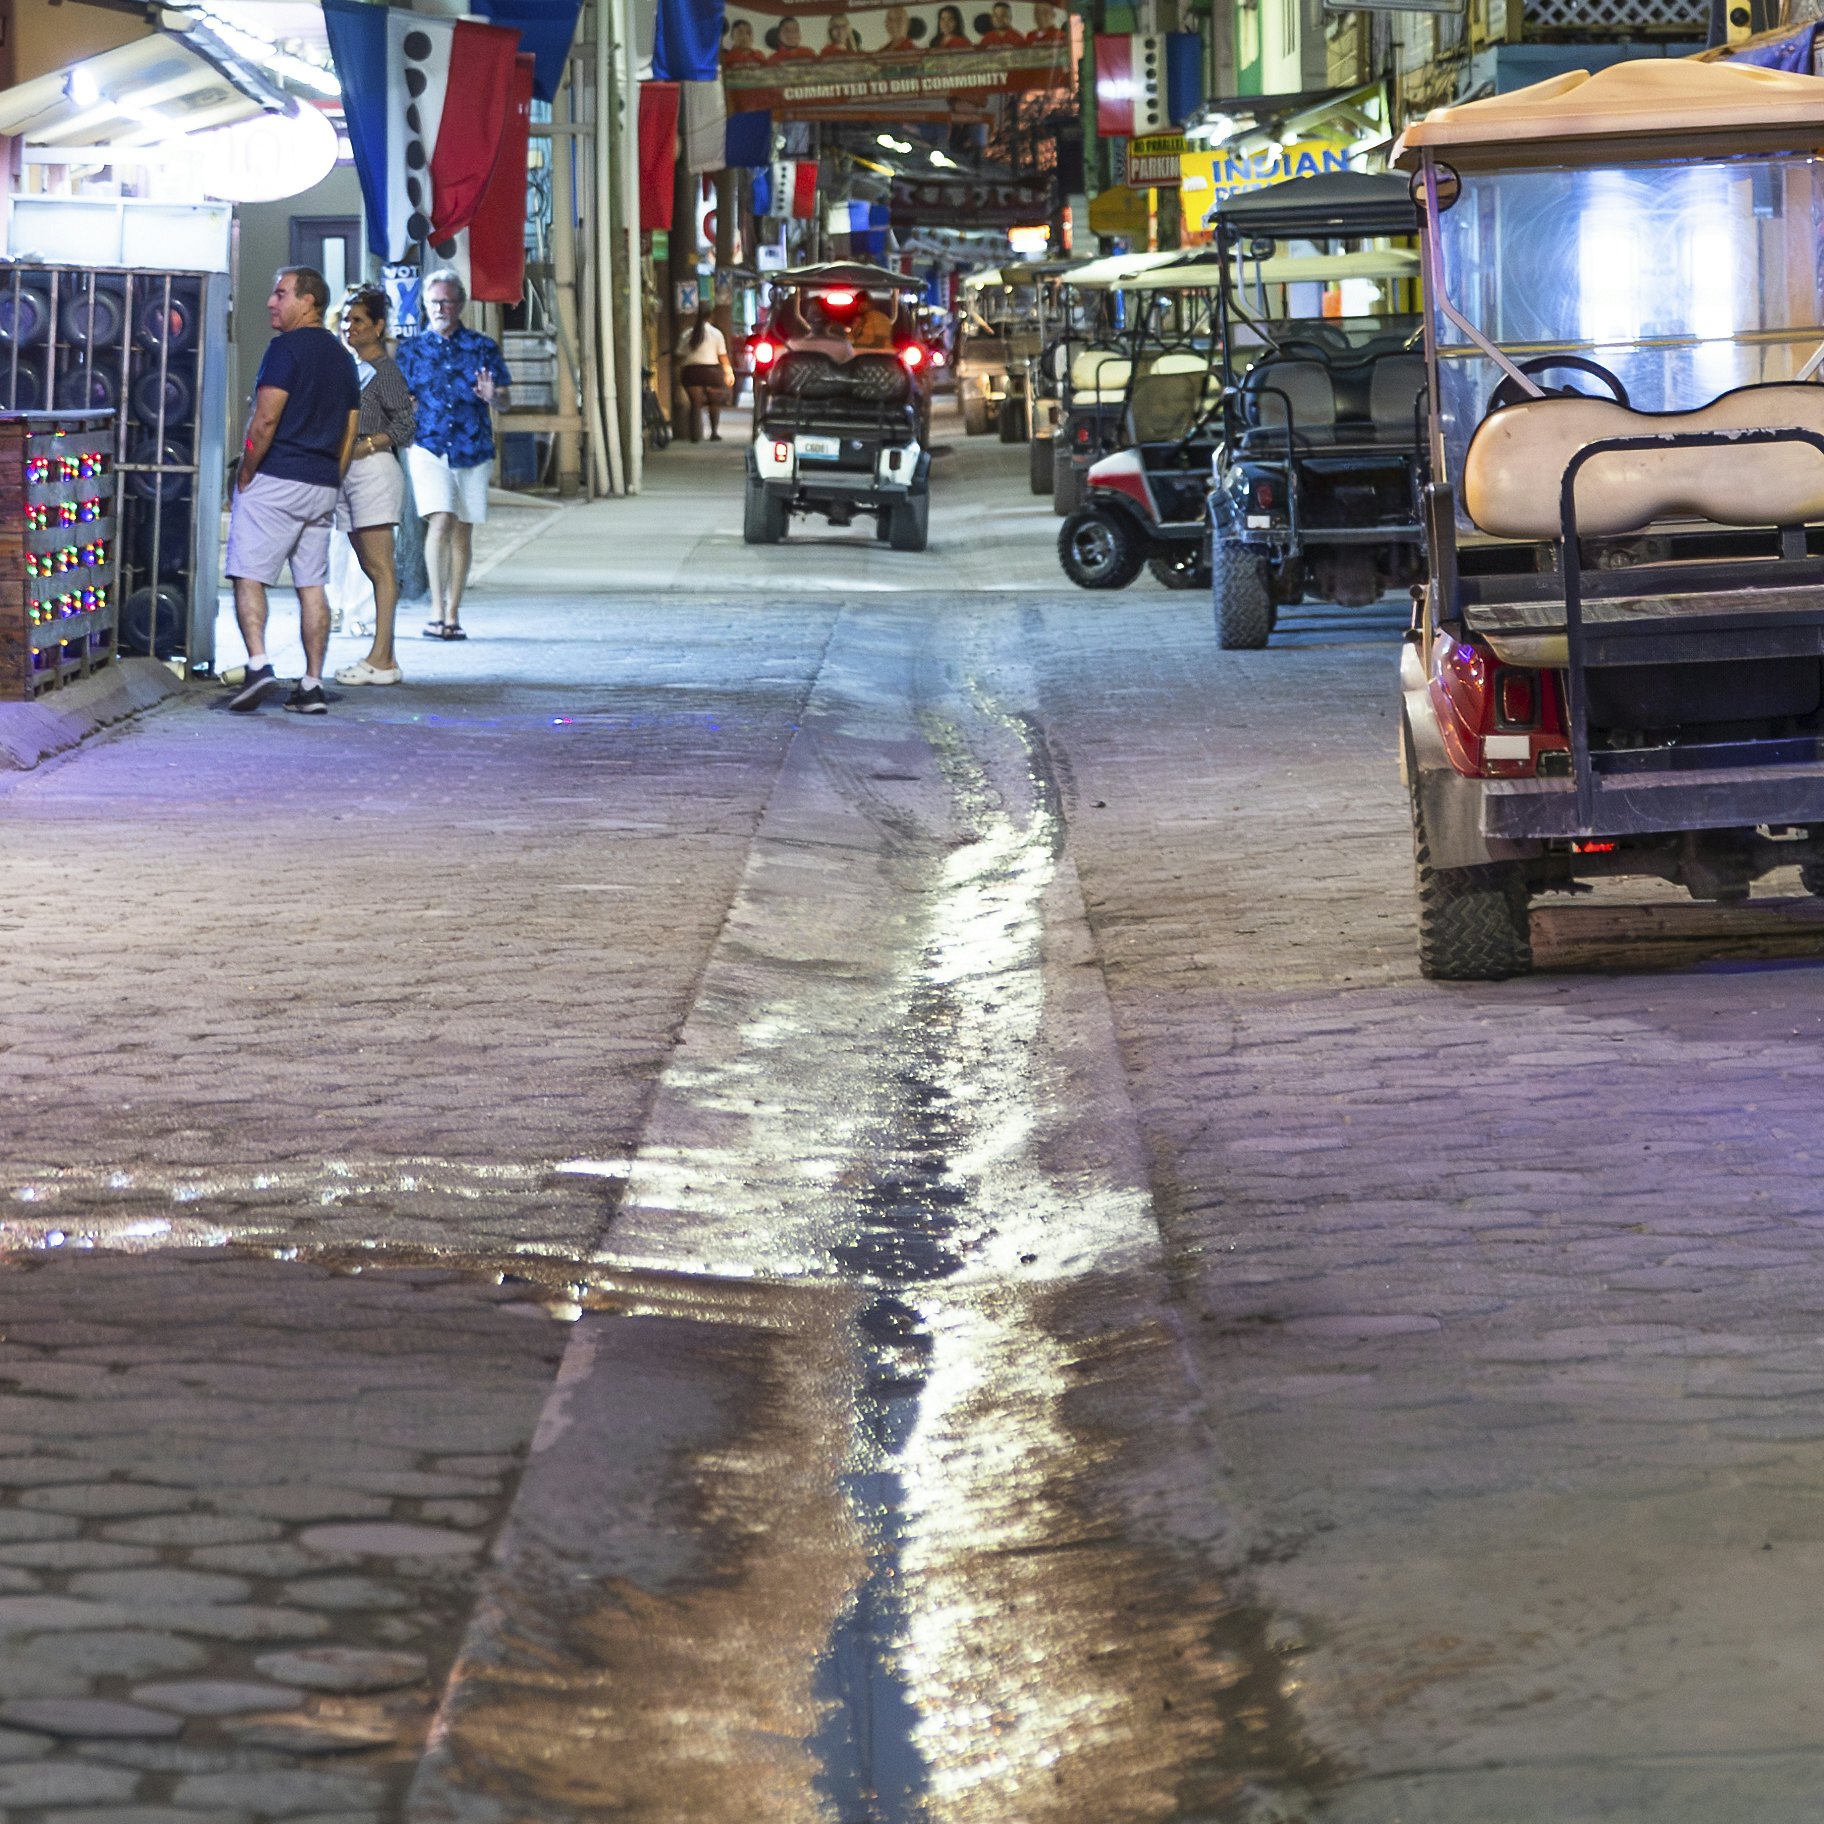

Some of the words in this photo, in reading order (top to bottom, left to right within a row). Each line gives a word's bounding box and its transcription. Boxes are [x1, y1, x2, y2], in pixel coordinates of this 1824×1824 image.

[783, 82, 867, 101] COMMITTED
[870, 80, 888, 95] TO
[890, 78, 920, 94] OUR
[921, 72, 1008, 92] COMMUNITY
[1212, 148, 1350, 183] INDIAN
